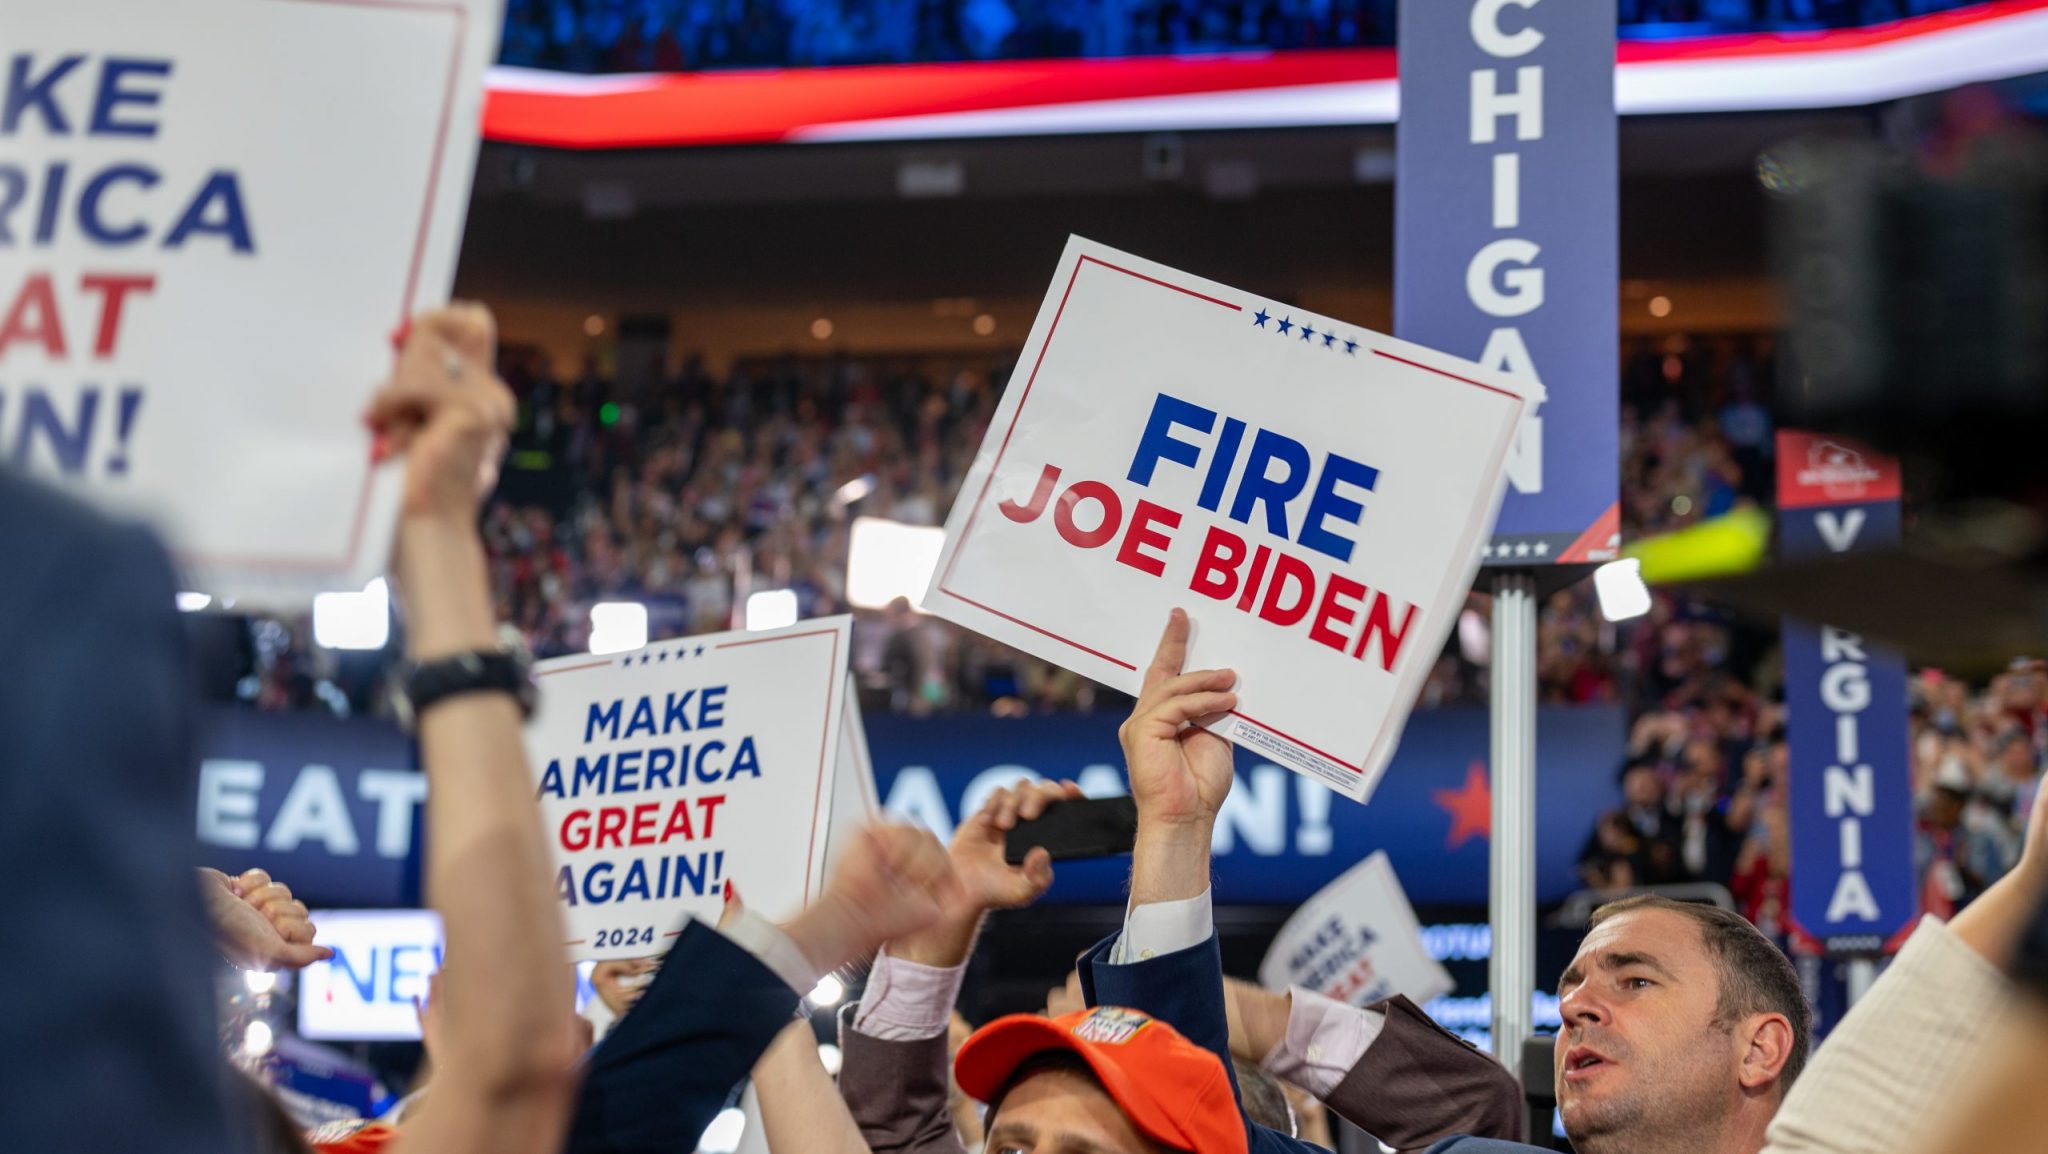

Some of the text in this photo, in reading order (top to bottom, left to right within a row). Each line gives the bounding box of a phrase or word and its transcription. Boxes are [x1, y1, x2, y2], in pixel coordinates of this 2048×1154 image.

[0, 388, 143, 475] N!
[1127, 393, 1381, 563] FIRE
[999, 464, 1420, 674] JOE BIDEN
[584, 685, 728, 743] MAKE
[1815, 509, 1880, 922] VRGINIA
[535, 736, 761, 801] AMERICA
[197, 760, 429, 857] EAT
[560, 794, 726, 853] GREAT
[553, 851, 724, 907] AGAIN!
[593, 926, 654, 949] 2024
[328, 946, 443, 1003] NE
